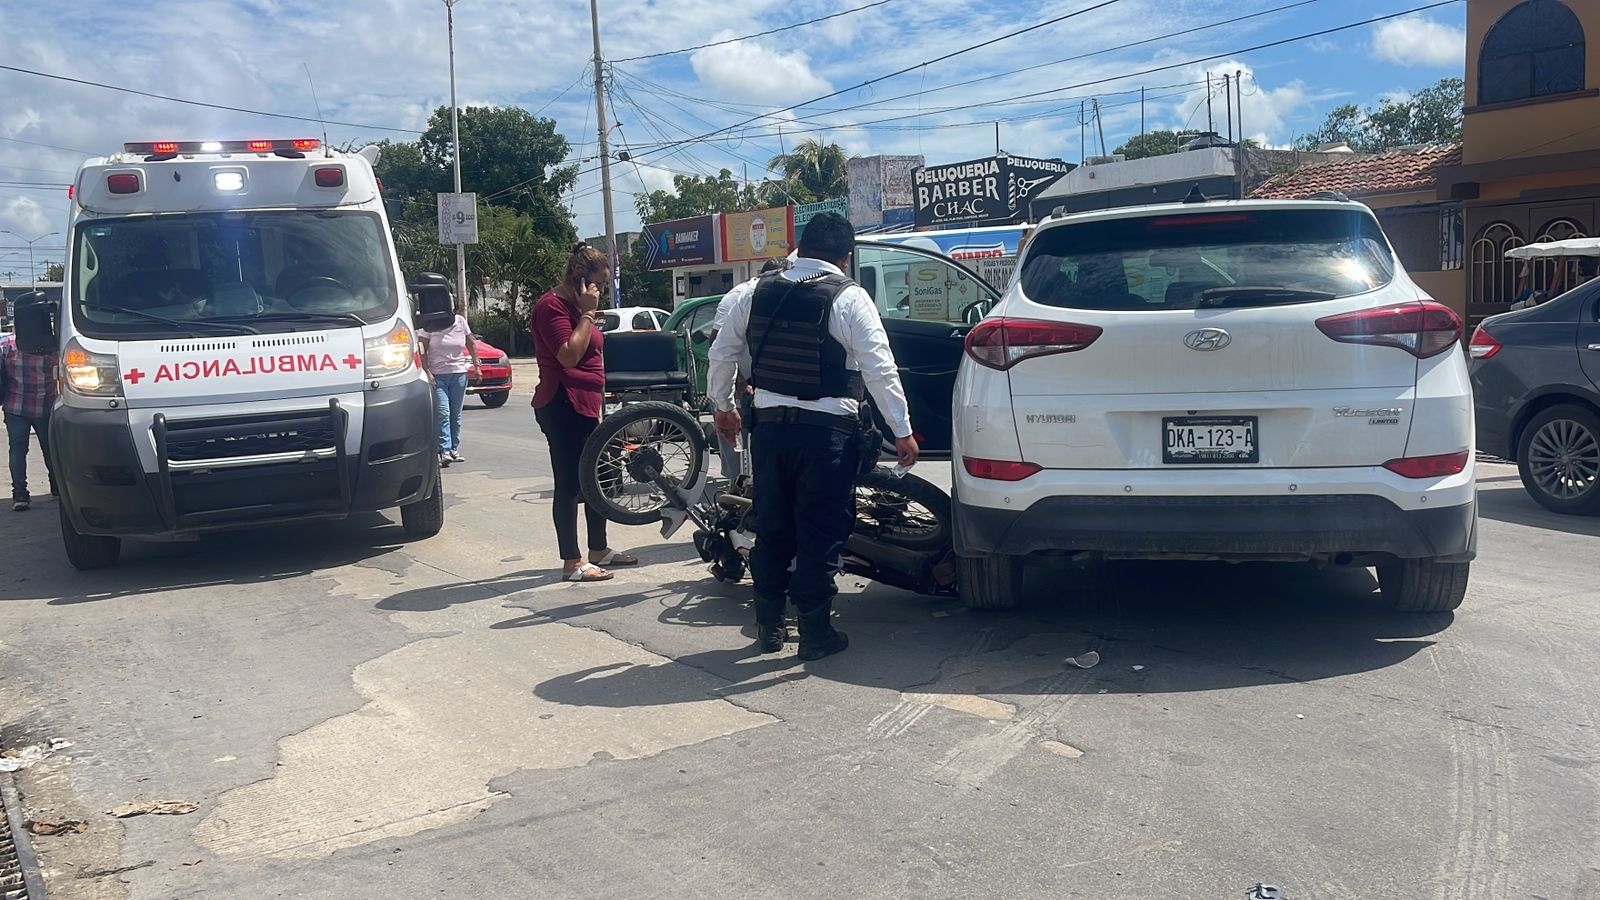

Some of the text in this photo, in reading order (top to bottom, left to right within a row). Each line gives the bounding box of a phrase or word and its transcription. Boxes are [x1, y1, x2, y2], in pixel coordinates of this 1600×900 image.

[915, 160, 1000, 185] PELUQUERIA
[1007, 157, 1068, 173] PELUQUERIA
[918, 177, 1000, 211] BARBER
[934, 199, 985, 218] CHAC
[914, 286, 943, 296] SoniGas
[1026, 414, 1076, 424] HYUNDAI
[1167, 428, 1253, 448] DKA-123-A
